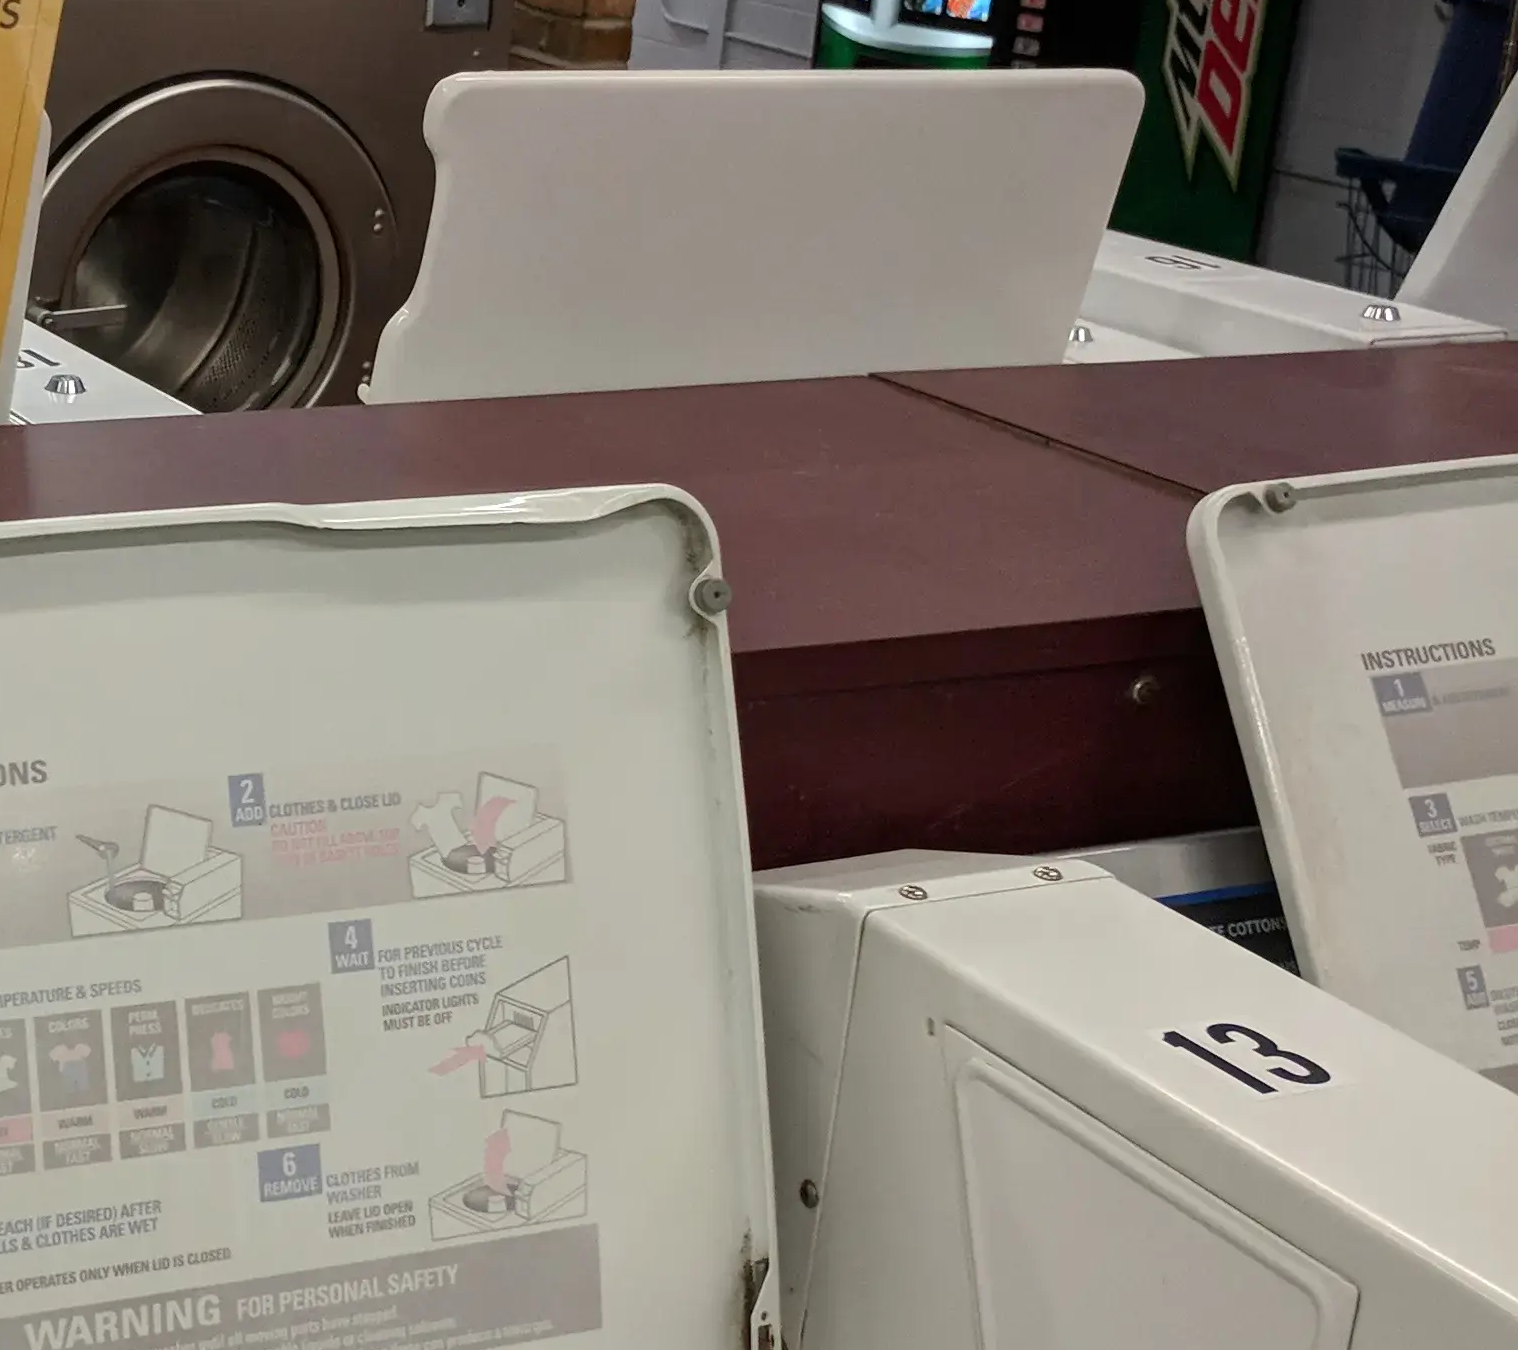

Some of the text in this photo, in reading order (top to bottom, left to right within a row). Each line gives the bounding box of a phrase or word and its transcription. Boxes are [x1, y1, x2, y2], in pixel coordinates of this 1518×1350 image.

[1360, 637, 1496, 671] INSTRUCTIONS
[1393, 678, 1405, 698] 1
[239, 779, 255, 804] 2
[235, 791, 402, 822] ADD CLOTHES & CLOSE LID
[1424, 799, 1438, 818] 3
[344, 925, 358, 950] 4
[335, 935, 503, 969] WAIT FOR PREVIOUS CYCLE
[379, 954, 487, 981] TO FINISH BEFORE
[75, 984, 86, 1000] &
[89, 979, 142, 999] SPEEDS
[380, 971, 487, 997] INSERTING COINS
[382, 993, 479, 1017] INDICATOR LIGHTS
[47, 1016, 91, 1034] COLORS
[129, 1022, 162, 1037] PRESS
[383, 1010, 453, 1032] MUST BE OFF
[1162, 1022, 1331, 1095] 13
[284, 1086, 310, 1100] COLD
[57, 1115, 94, 1130] WARM
[133, 1105, 168, 1120] WARM
[282, 1151, 297, 1177] 6
[264, 1160, 420, 1197] REMOVE CLOTHES FROM
[326, 1184, 382, 1206] WASHER
[35, 1214, 53, 1232] (IF
[56, 1205, 118, 1229] DESIRED)
[120, 1200, 163, 1220] AFTER
[327, 1199, 414, 1225] LEAVE LID OPEN
[20, 1237, 33, 1251] &
[35, 1226, 96, 1249] CLOTHES
[98, 1223, 126, 1240] ARE
[128, 1217, 159, 1235] WET
[327, 1214, 417, 1239] WHEN FINISHED
[16, 1271, 78, 1293] OPERATES
[79, 1265, 112, 1283] ONLY
[112, 1259, 150, 1278] WHEN
[152, 1257, 171, 1272] LID
[173, 1254, 185, 1268] IS
[186, 1246, 232, 1266] CLOSED
[236, 1292, 275, 1323] FOR
[280, 1276, 386, 1314] PERSONAL
[387, 1263, 459, 1296] SAFETY
